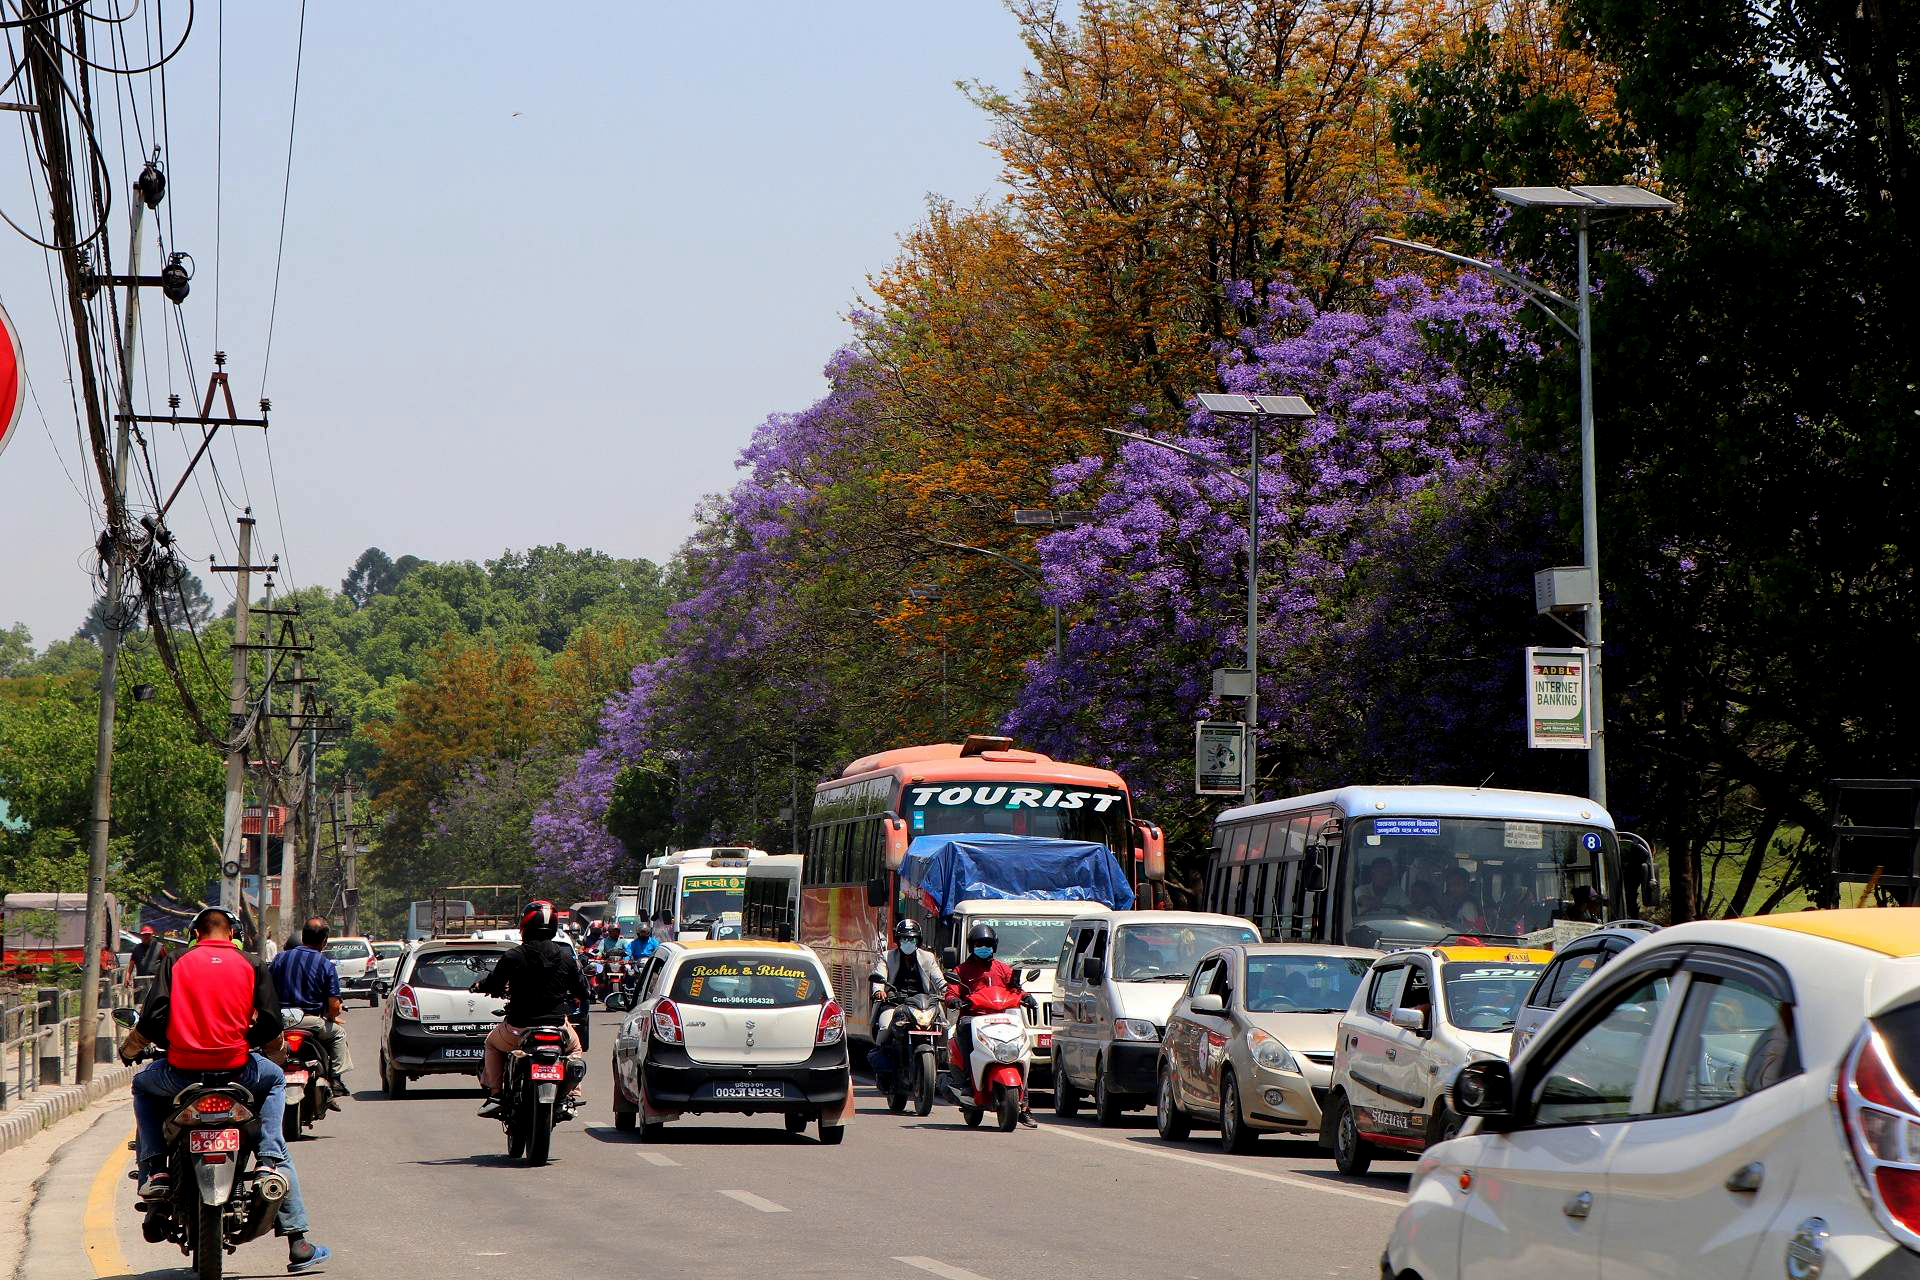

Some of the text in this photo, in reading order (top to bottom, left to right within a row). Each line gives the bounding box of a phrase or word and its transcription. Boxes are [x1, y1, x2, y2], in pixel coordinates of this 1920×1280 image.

[1535, 681, 1579, 693] INTERNET
[1537, 694, 1577, 706] BANKING
[912, 787, 1122, 812] TOURIST
[1587, 836, 1596, 849] 8
[692, 965, 806, 978] Reshu & Ridam
[691, 978, 704, 996] TAXI
[796, 980, 810, 999] TAXI
[1371, 1110, 1408, 1129] SUZUKI
